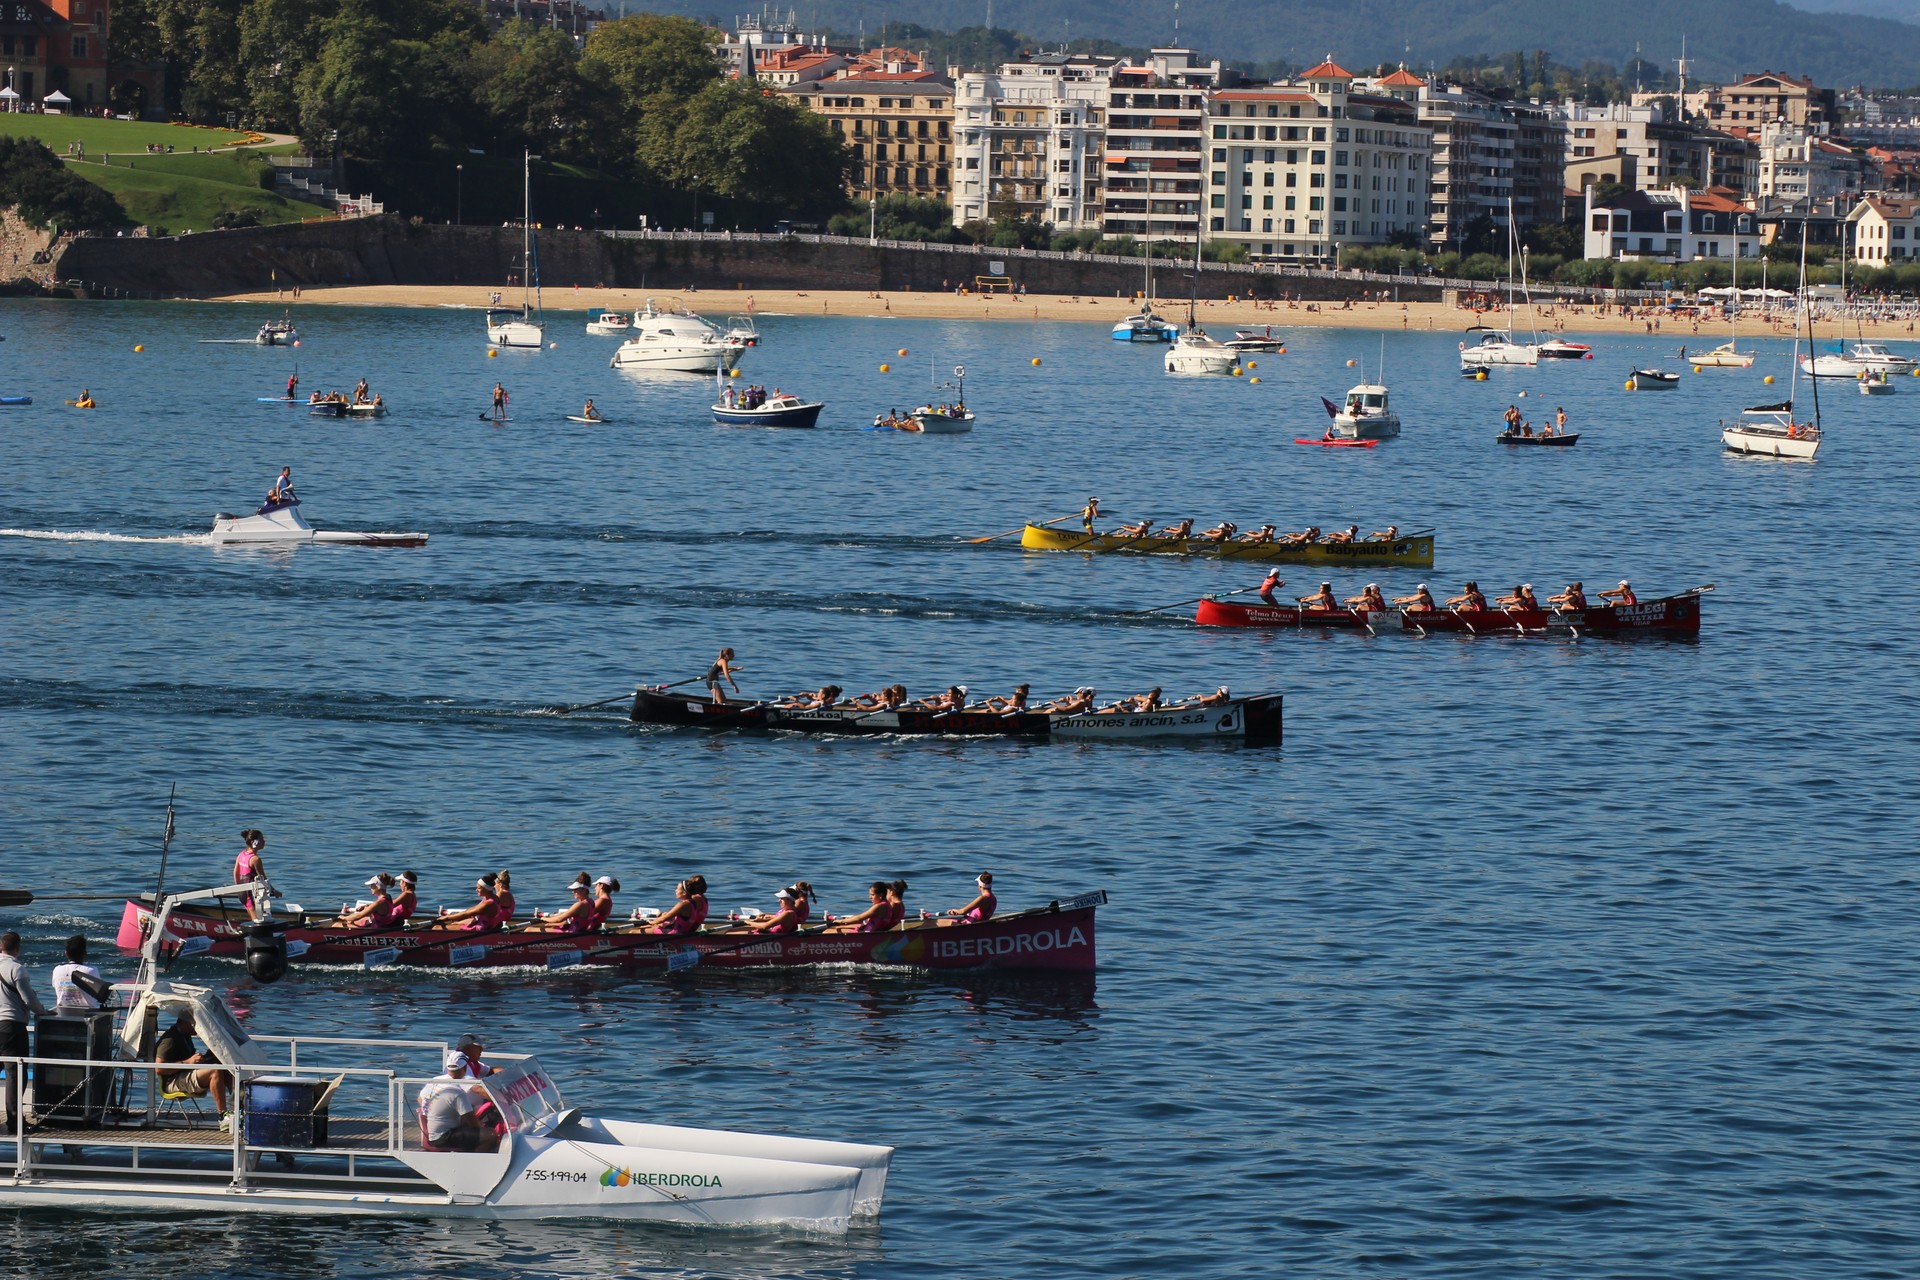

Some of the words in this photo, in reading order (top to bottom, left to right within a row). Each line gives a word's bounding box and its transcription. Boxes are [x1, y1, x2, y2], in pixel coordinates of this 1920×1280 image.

[1326, 544, 1387, 557] Babyauto
[1245, 608, 1270, 617] Telmo
[1616, 602, 1667, 616] SALEGI
[1054, 715, 1126, 729] jamones
[172, 917, 208, 932] SAN
[739, 942, 783, 954] DOMIKO
[800, 941, 863, 949] EuskoAuto
[933, 926, 1087, 958] IBERDROLA
[632, 1172, 722, 1188] IBERDROLA
